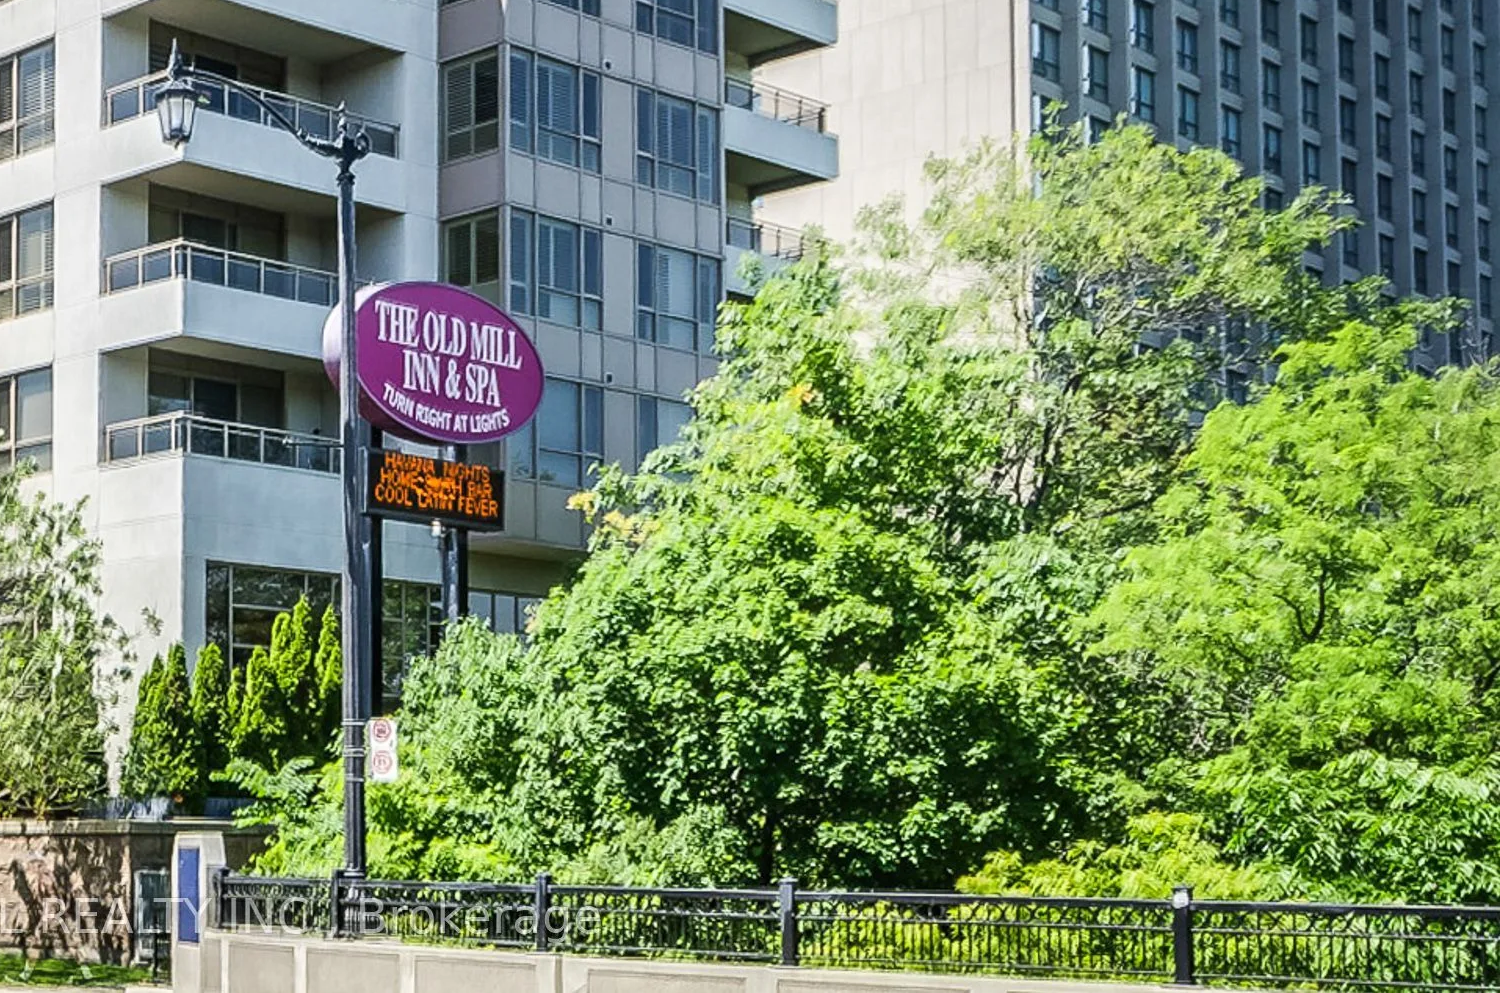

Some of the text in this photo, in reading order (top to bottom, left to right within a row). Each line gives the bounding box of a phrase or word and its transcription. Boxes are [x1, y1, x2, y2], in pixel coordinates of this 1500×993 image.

[374, 299, 522, 370] THE OLD MILL
[402, 349, 501, 407] INN & SPA
[383, 383, 510, 432] TURN RIGHT AT LIGHTS
[374, 483, 413, 506] COOL
[458, 496, 498, 517] FEVER
